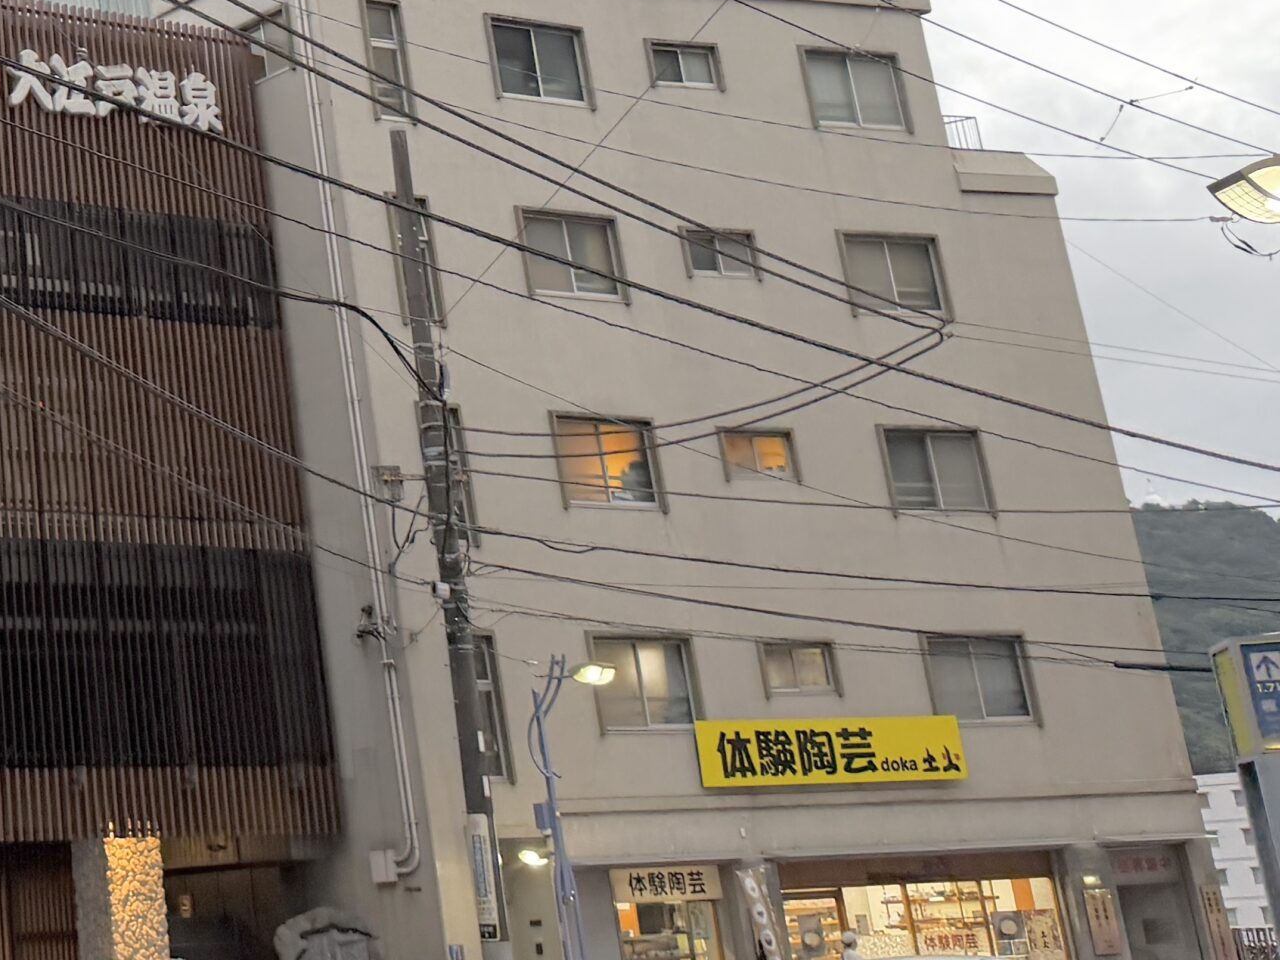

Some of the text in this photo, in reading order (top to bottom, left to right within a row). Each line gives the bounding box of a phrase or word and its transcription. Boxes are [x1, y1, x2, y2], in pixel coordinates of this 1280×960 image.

[5, 48, 224, 134] 大江戸温泉
[716, 727, 879, 779] 体験陶芸
[881, 756, 919, 772] doka
[629, 869, 707, 897] 体験陶芸
[924, 933, 979, 952] 体験陶芸
